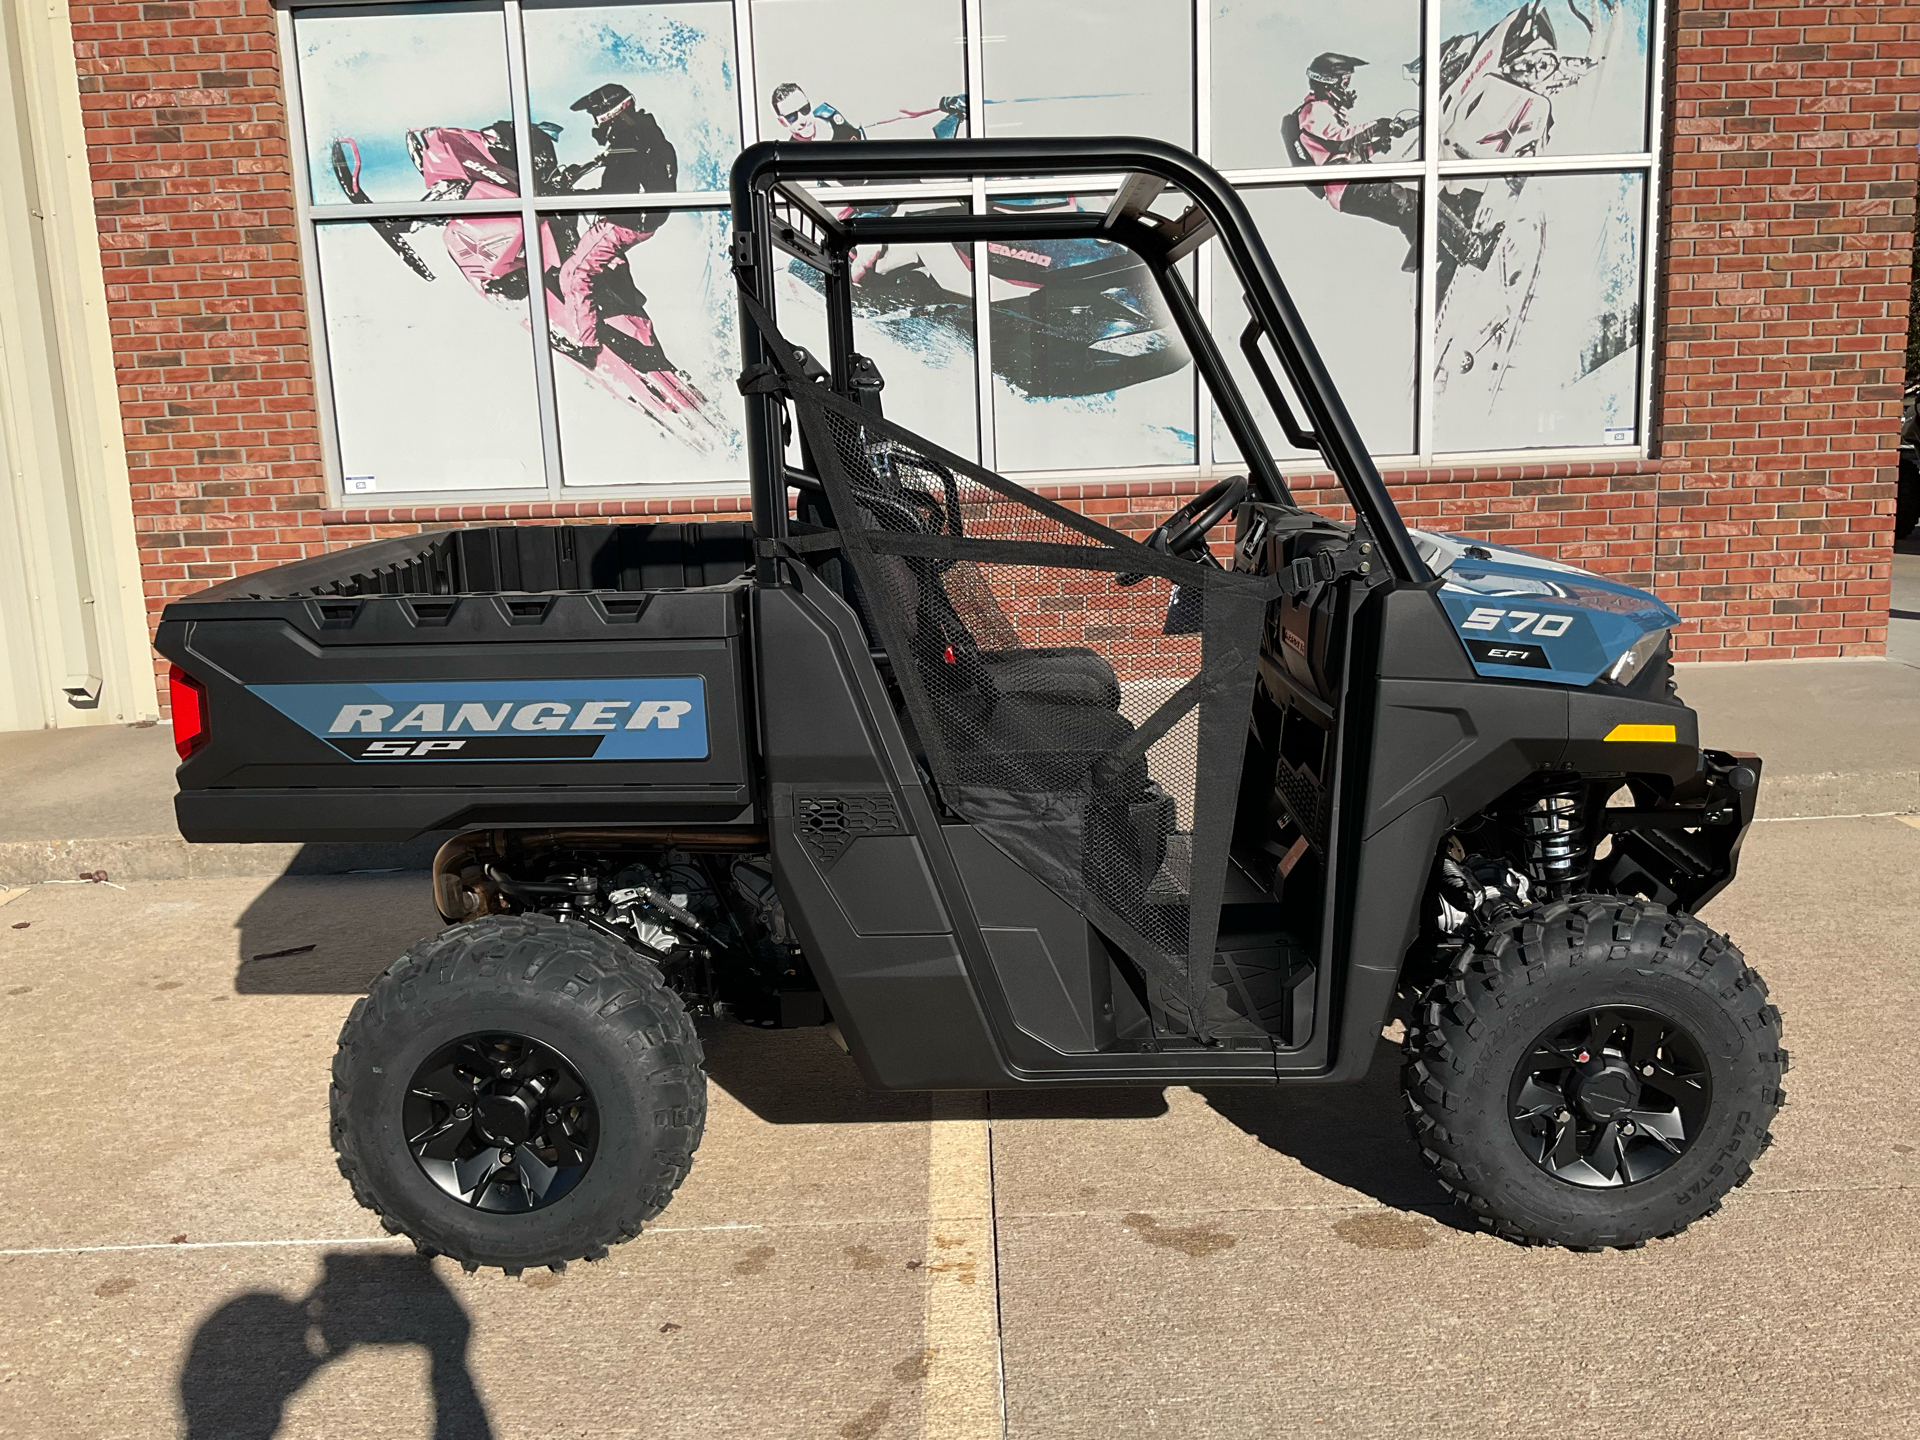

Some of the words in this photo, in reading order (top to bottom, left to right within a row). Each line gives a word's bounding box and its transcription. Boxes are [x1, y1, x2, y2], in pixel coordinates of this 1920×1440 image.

[1460, 607, 1574, 637] 570
[1487, 649, 1529, 660] EFI
[328, 701, 692, 733] RANGER
[361, 740, 467, 756] SP
[1675, 1111, 1751, 1205] CARLSTAR
